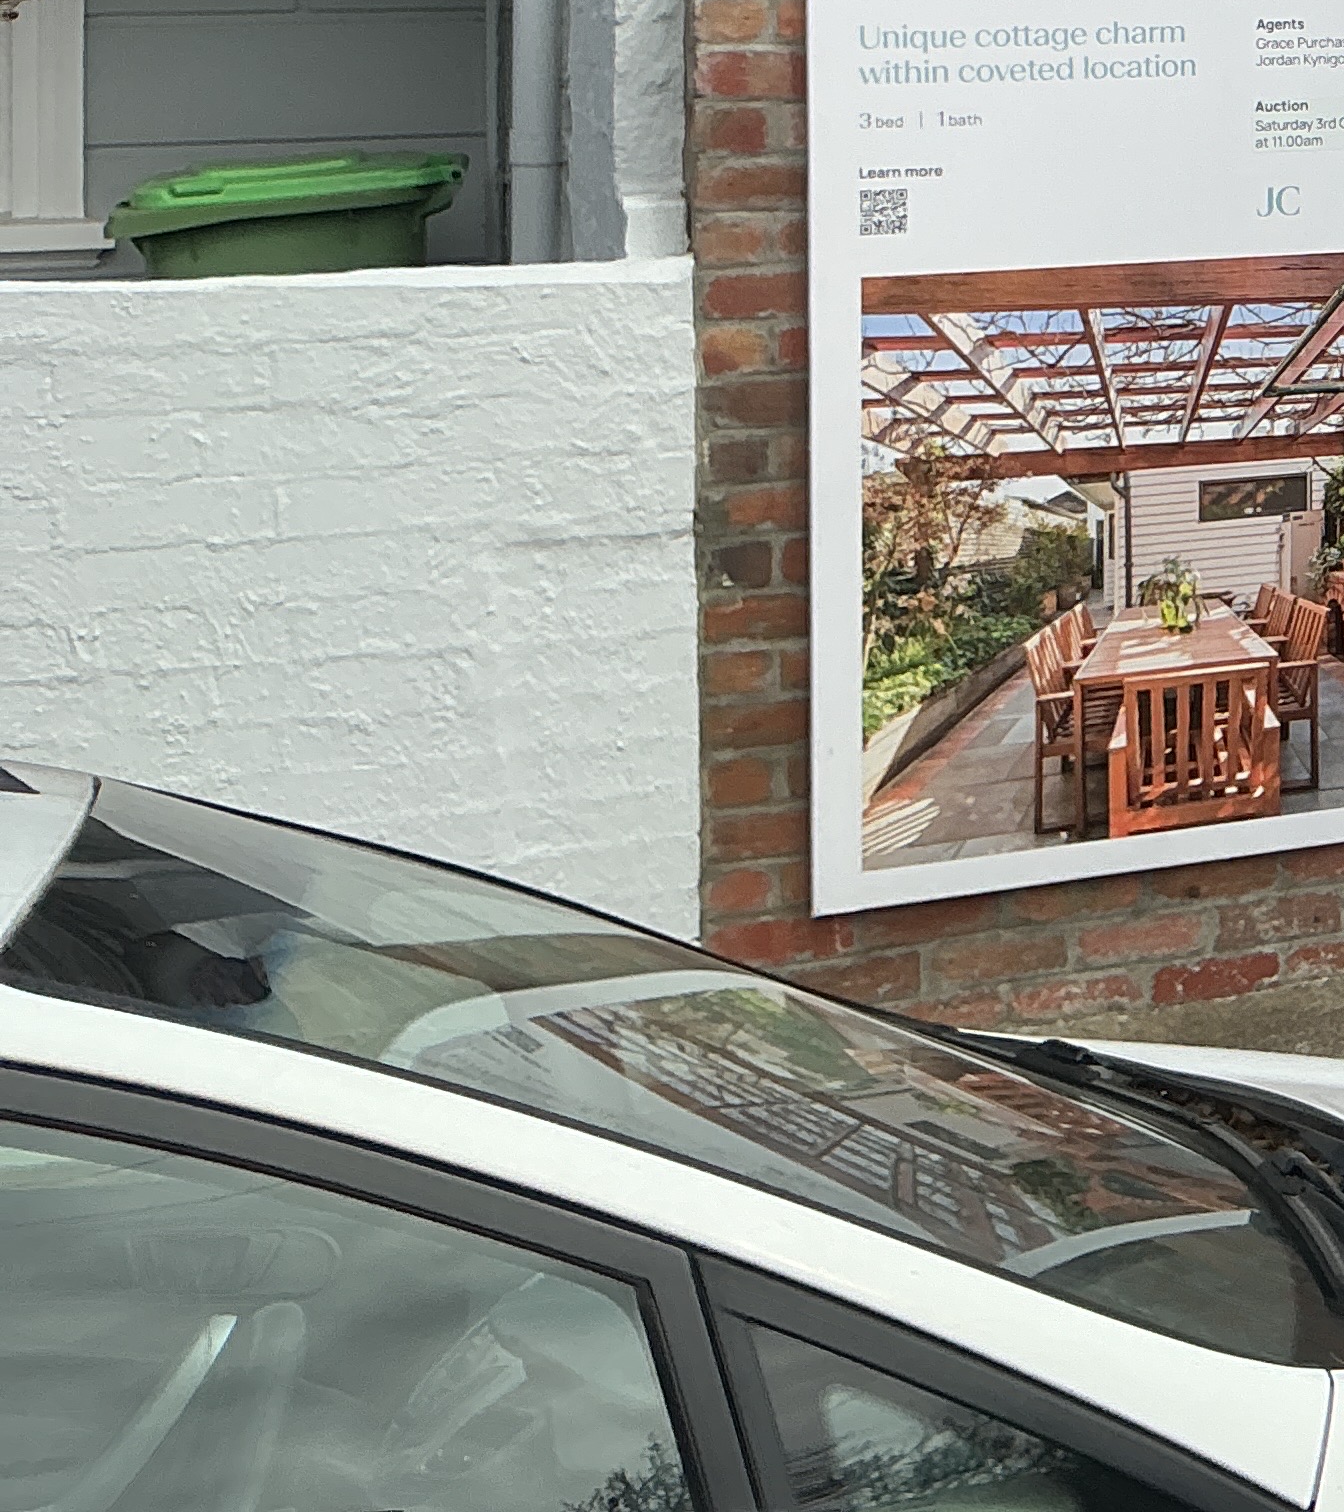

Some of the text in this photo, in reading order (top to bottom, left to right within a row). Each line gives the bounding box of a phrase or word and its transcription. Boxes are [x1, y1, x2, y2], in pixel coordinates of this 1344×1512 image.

[1256, 18, 1305, 34] Agents
[859, 20, 1186, 55] Unique cottage charm
[1255, 37, 1295, 50] Grace
[1255, 54, 1301, 67] Jordan
[858, 53, 1197, 85] within coveted location
[1255, 99, 1309, 113] Auction
[1255, 119, 1314, 133] Saturday
[1315, 117, 1336, 130] 3rd
[1255, 135, 1324, 149] at 11.00am
[858, 167, 943, 180] Learn more
[1256, 185, 1301, 218] JC
